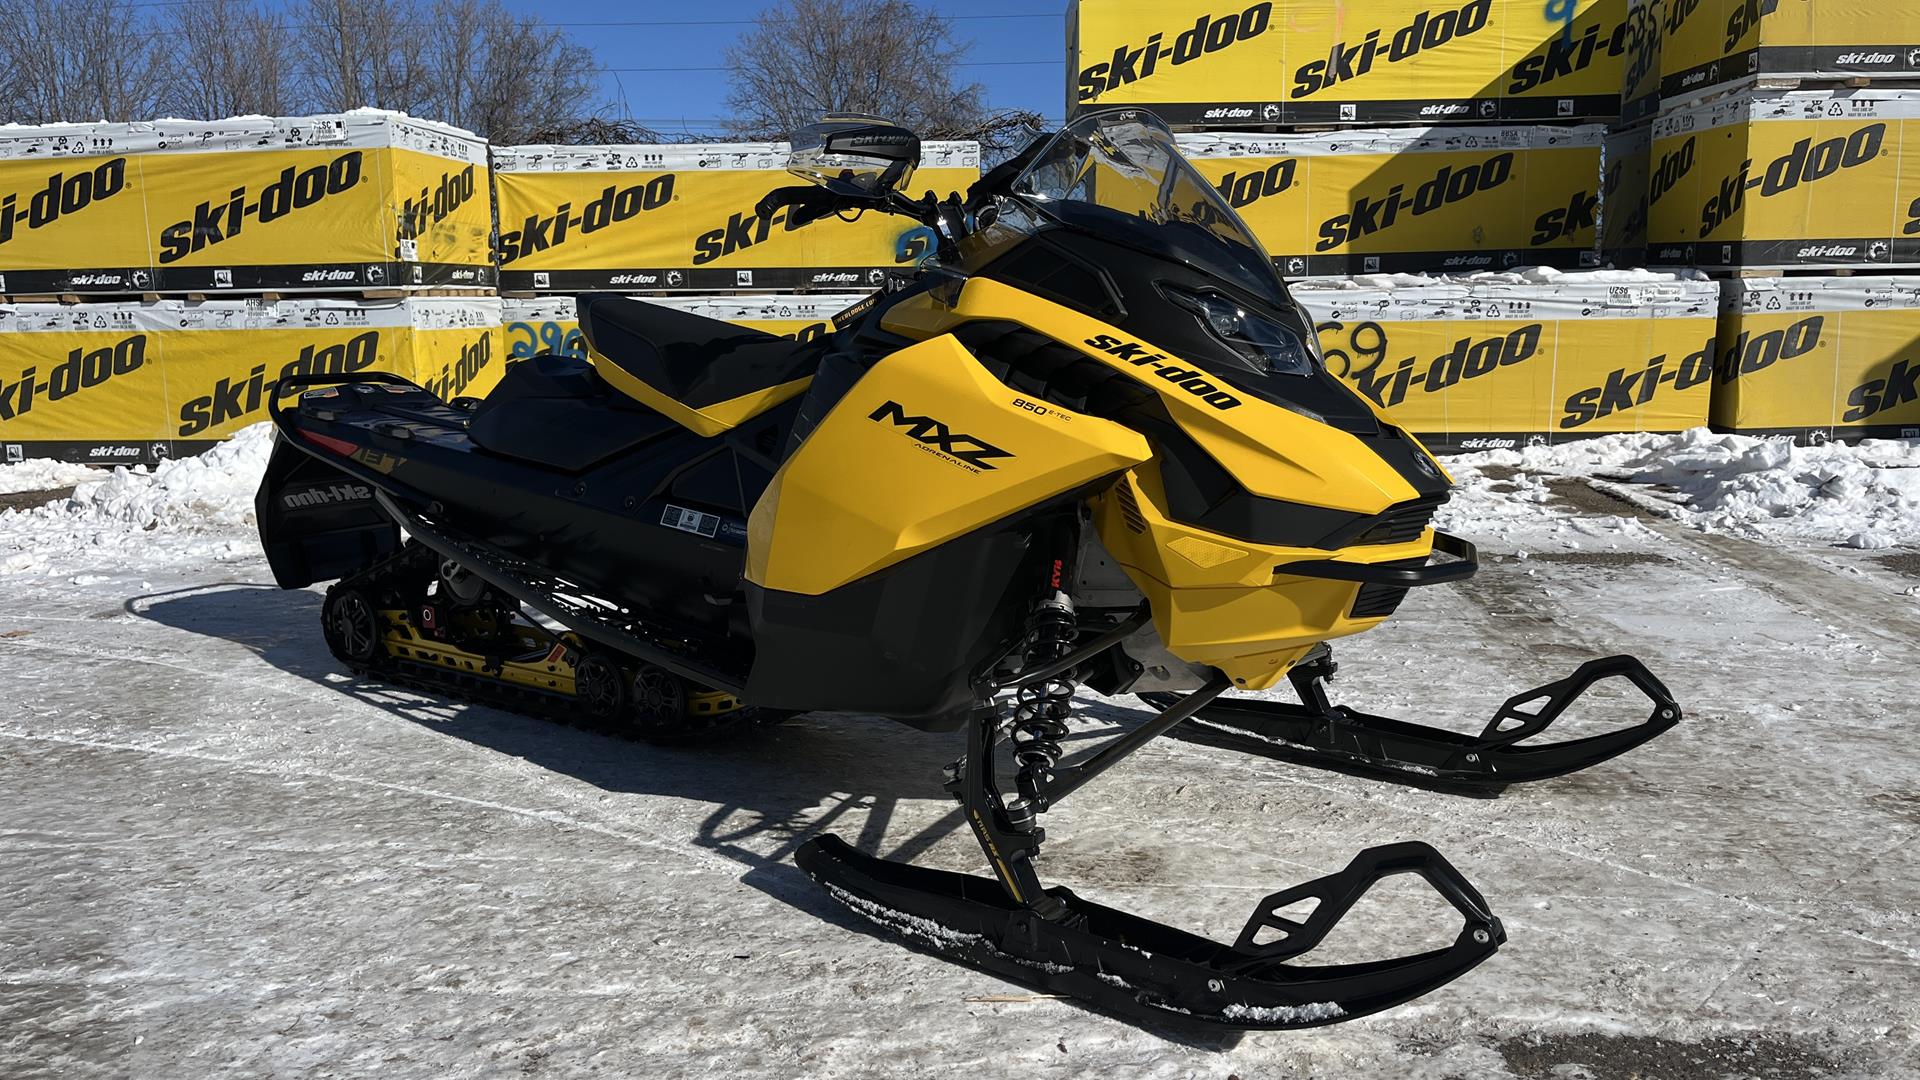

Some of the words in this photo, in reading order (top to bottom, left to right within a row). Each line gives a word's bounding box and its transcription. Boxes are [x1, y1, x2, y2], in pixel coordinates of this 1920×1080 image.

[1079, 2, 1272, 101] ski-doo
[1291, 0, 1491, 99] ski-doo
[1836, 52, 1896, 64] ski-doo
[1204, 107, 1253, 119] ski-doo
[1420, 104, 1470, 116] ski-doo
[1700, 122, 1886, 239] ski-doo
[0, 158, 127, 245] i-doo
[159, 151, 362, 264] ski-doo
[1315, 152, 1514, 253] ski-doo
[489, 174, 675, 265] ski-doo
[1797, 245, 1856, 257] ski-doo
[1443, 256, 1492, 266] ski-doo
[71, 275, 121, 285] ski-doo
[302, 270, 355, 281] ski-doo
[452, 270, 474, 280] ski-doo
[610, 274, 657, 284] ski-doo
[812, 273, 859, 283] ski-doo
[1084, 334, 1243, 411] ski-doo
[179, 331, 380, 437] ski-doo
[1012, 398, 1048, 416] 850
[1048, 409, 1073, 422] E-TEC
[867, 400, 1017, 470] MXZ
[1460, 438, 1515, 449] ski-doo
[89, 446, 140, 457] ski-doo
[914, 443, 983, 475] ADRENALINE
